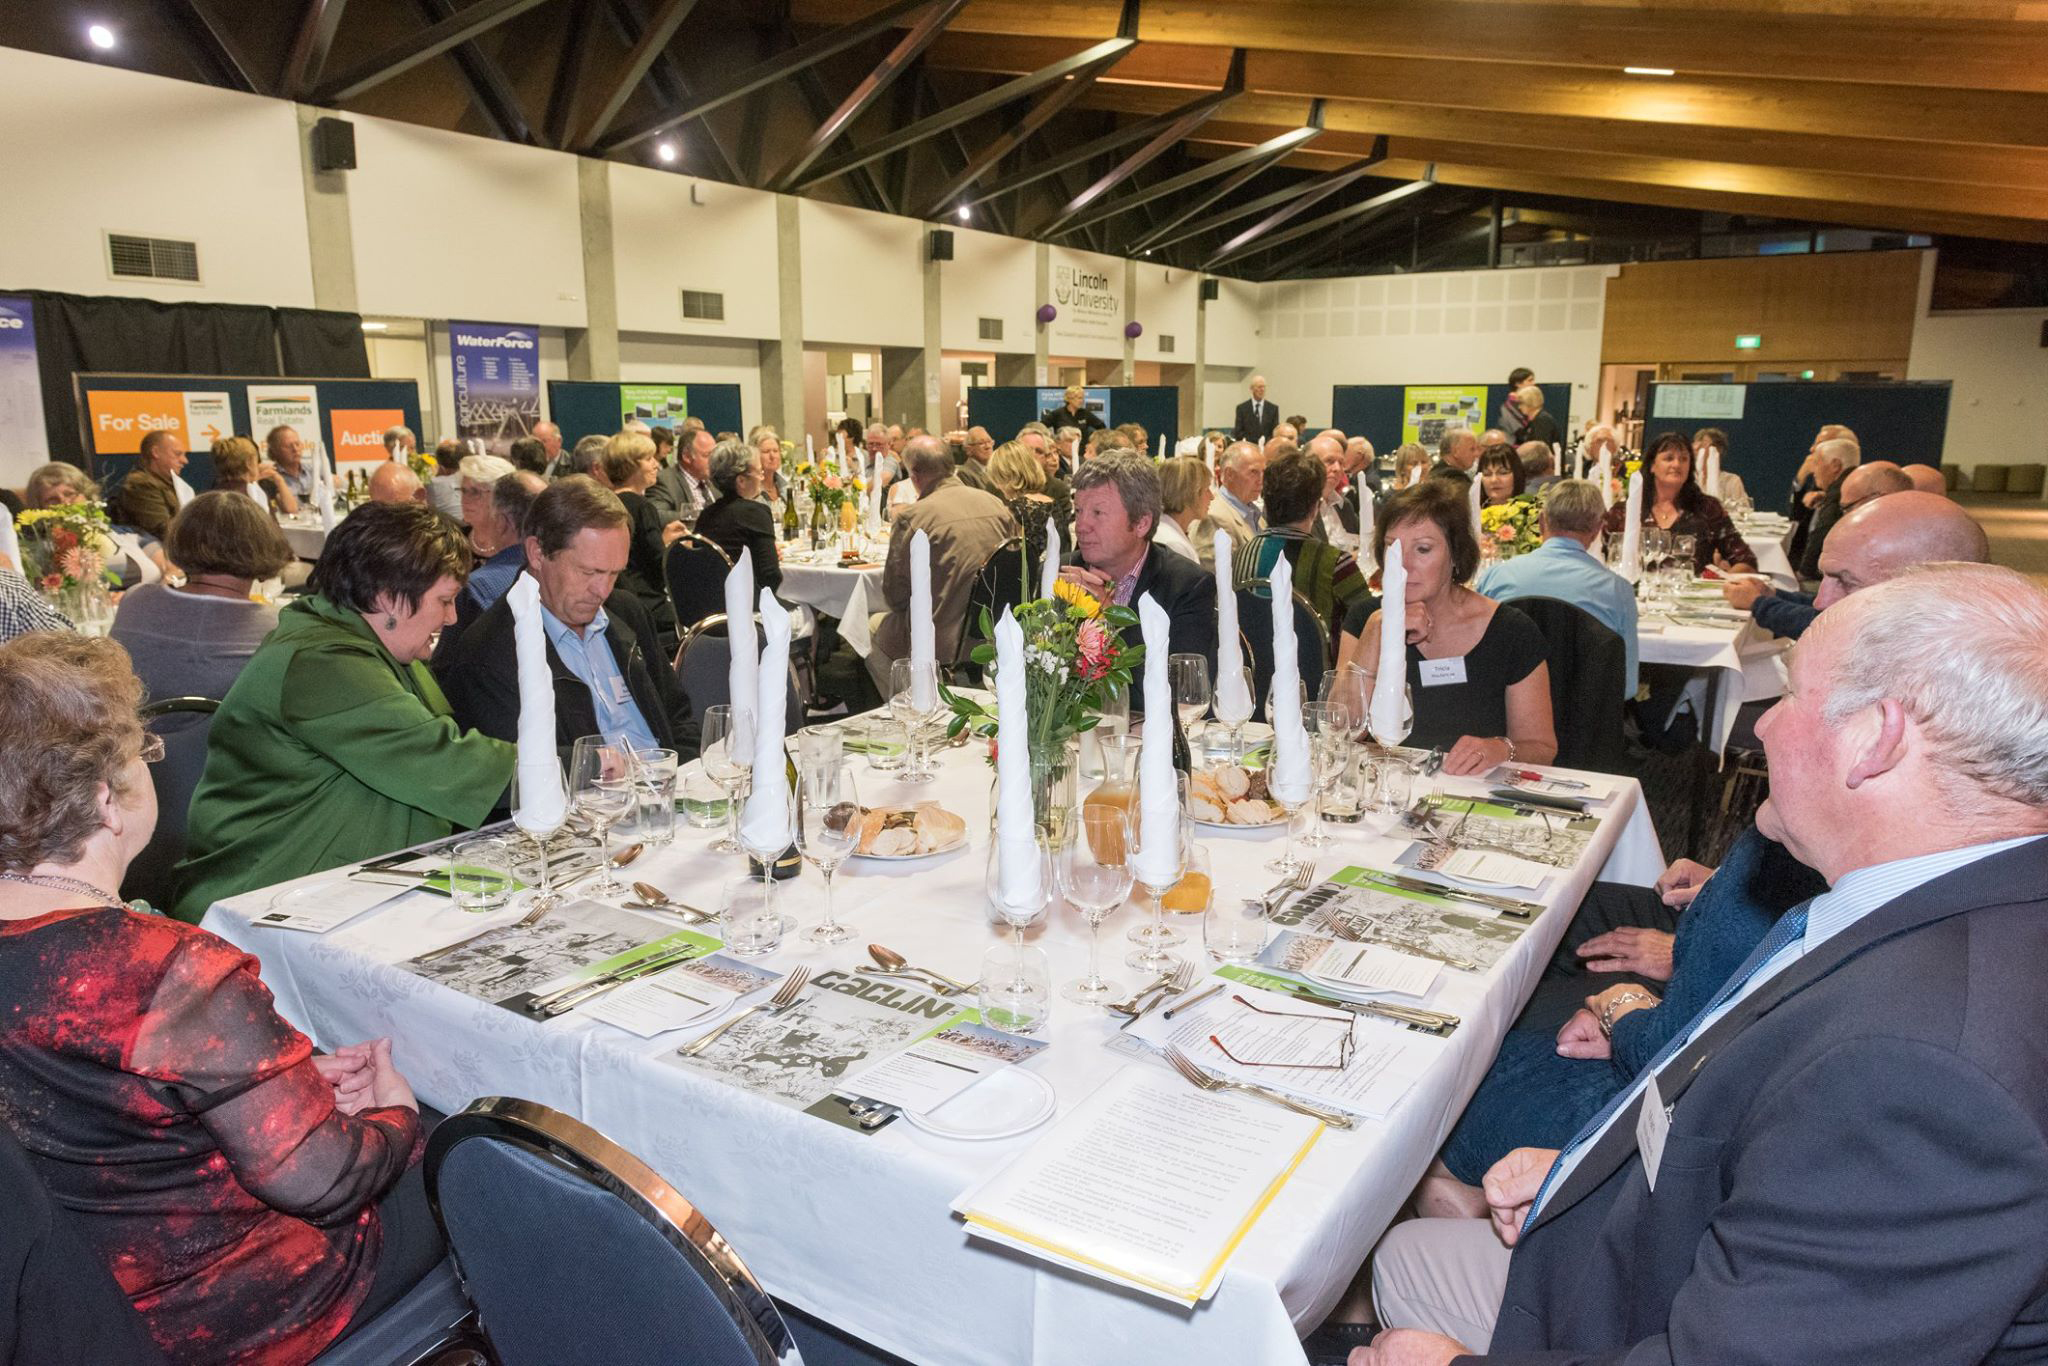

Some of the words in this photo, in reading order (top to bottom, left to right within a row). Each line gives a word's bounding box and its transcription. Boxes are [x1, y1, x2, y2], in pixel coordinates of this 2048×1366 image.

[1073, 268, 1108, 291] Lincoln
[1073, 288, 1119, 315] University
[457, 334, 534, 349] WaterForce
[456, 355, 470, 427] agriculture
[256, 405, 312, 415] Farmlands
[99, 414, 133, 431] For
[138, 413, 180, 431] Sale
[257, 416, 276, 424] Real
